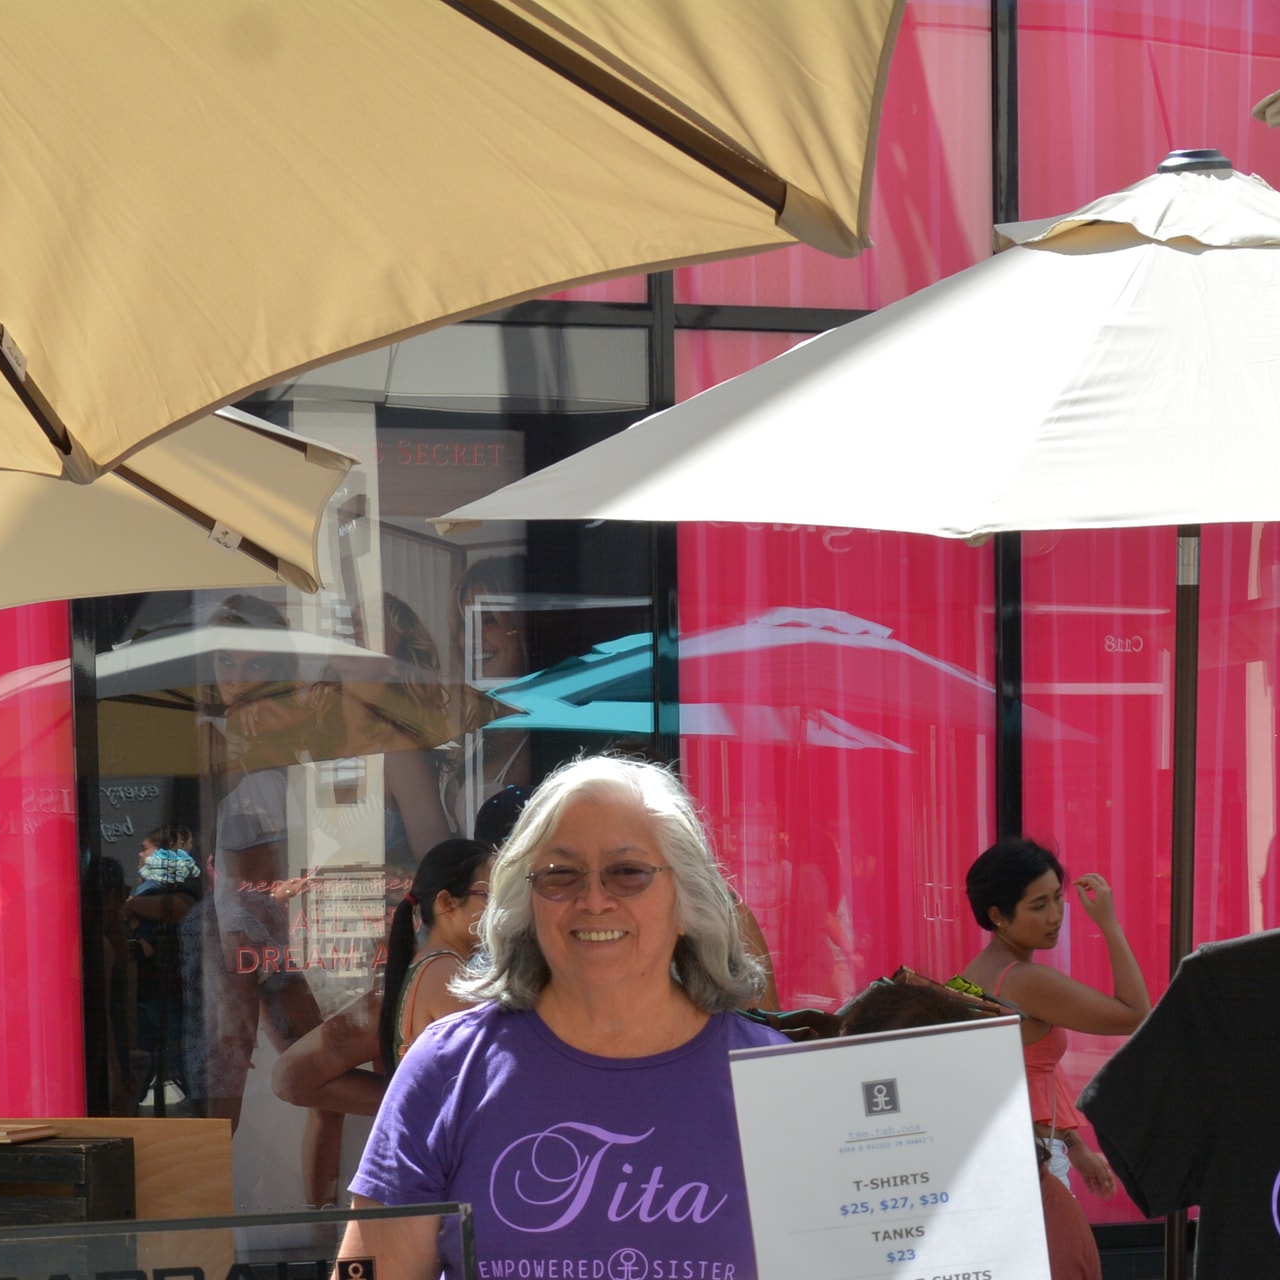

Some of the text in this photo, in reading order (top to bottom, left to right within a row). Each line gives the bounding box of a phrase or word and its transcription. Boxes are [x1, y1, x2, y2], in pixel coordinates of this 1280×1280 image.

[236, 944, 356, 973] DREAM
[489, 1121, 728, 1233] Tita
[853, 1172, 930, 1192] T-SHIRTS
[840, 1191, 949, 1218] $25, $27, $30
[872, 1226, 925, 1243] TANKS
[886, 1249, 916, 1264] $23
[479, 1259, 605, 1280] EMPOWERED
